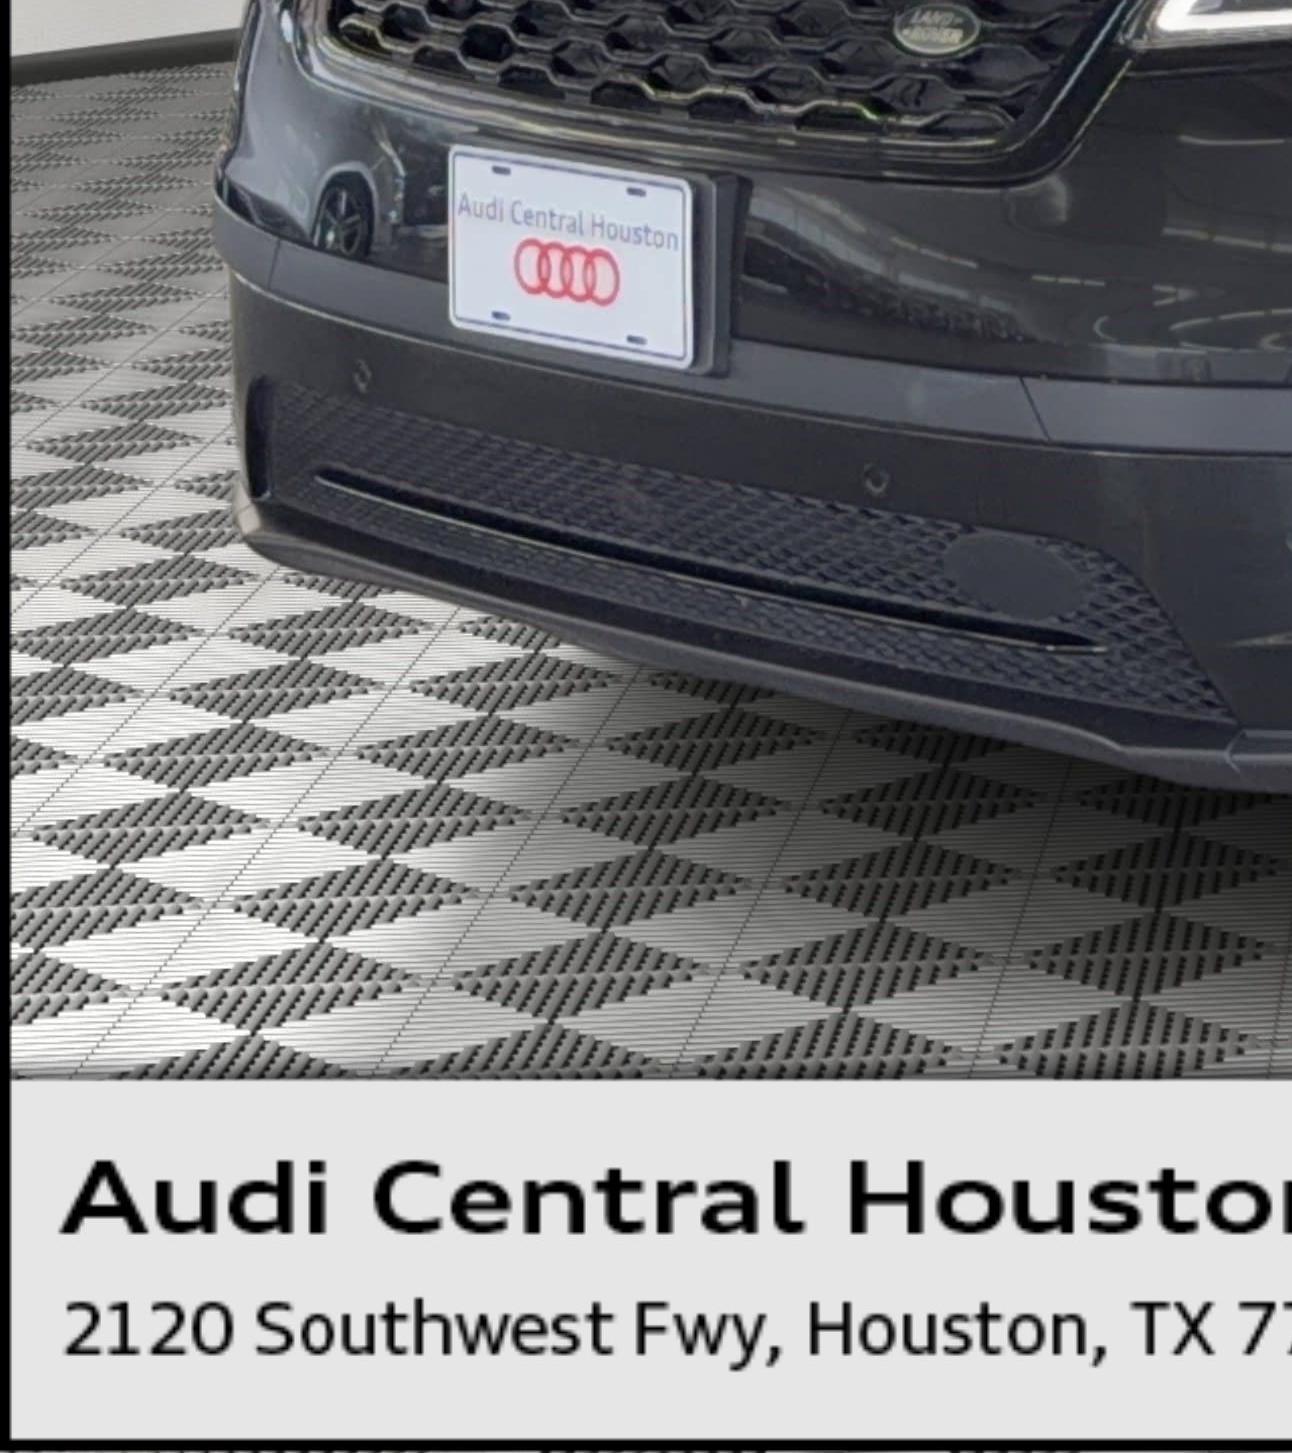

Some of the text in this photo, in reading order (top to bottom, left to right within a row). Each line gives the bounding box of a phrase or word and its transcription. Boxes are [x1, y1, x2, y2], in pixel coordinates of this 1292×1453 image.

[457, 193, 679, 251] Audi Central Houston
